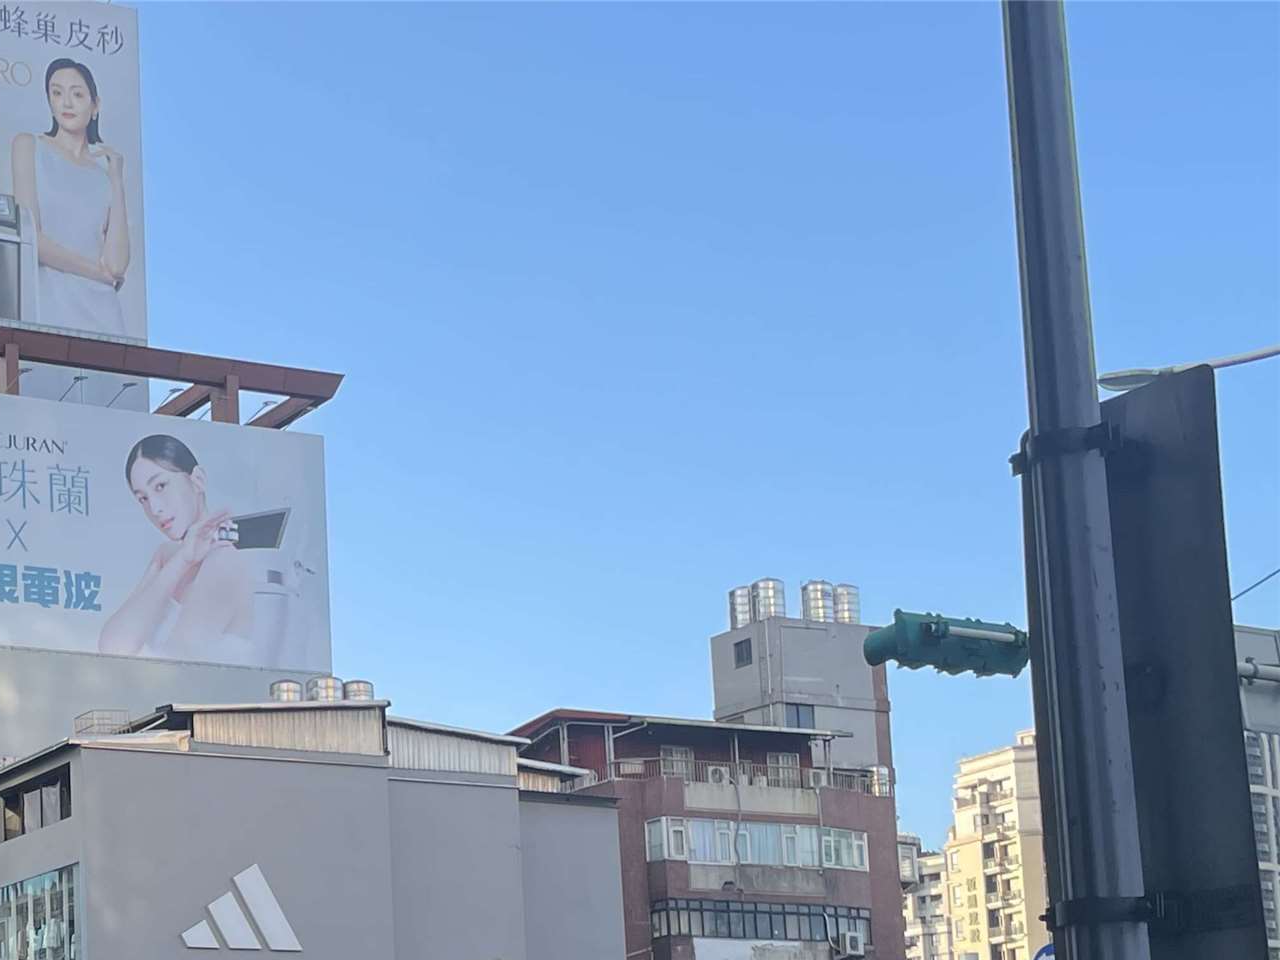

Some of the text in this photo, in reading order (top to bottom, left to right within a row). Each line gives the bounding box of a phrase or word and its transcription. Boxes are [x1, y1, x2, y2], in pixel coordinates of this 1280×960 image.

[0, 4, 124, 55] 蜂巢皮秒
[6, 518, 28, 551] X
